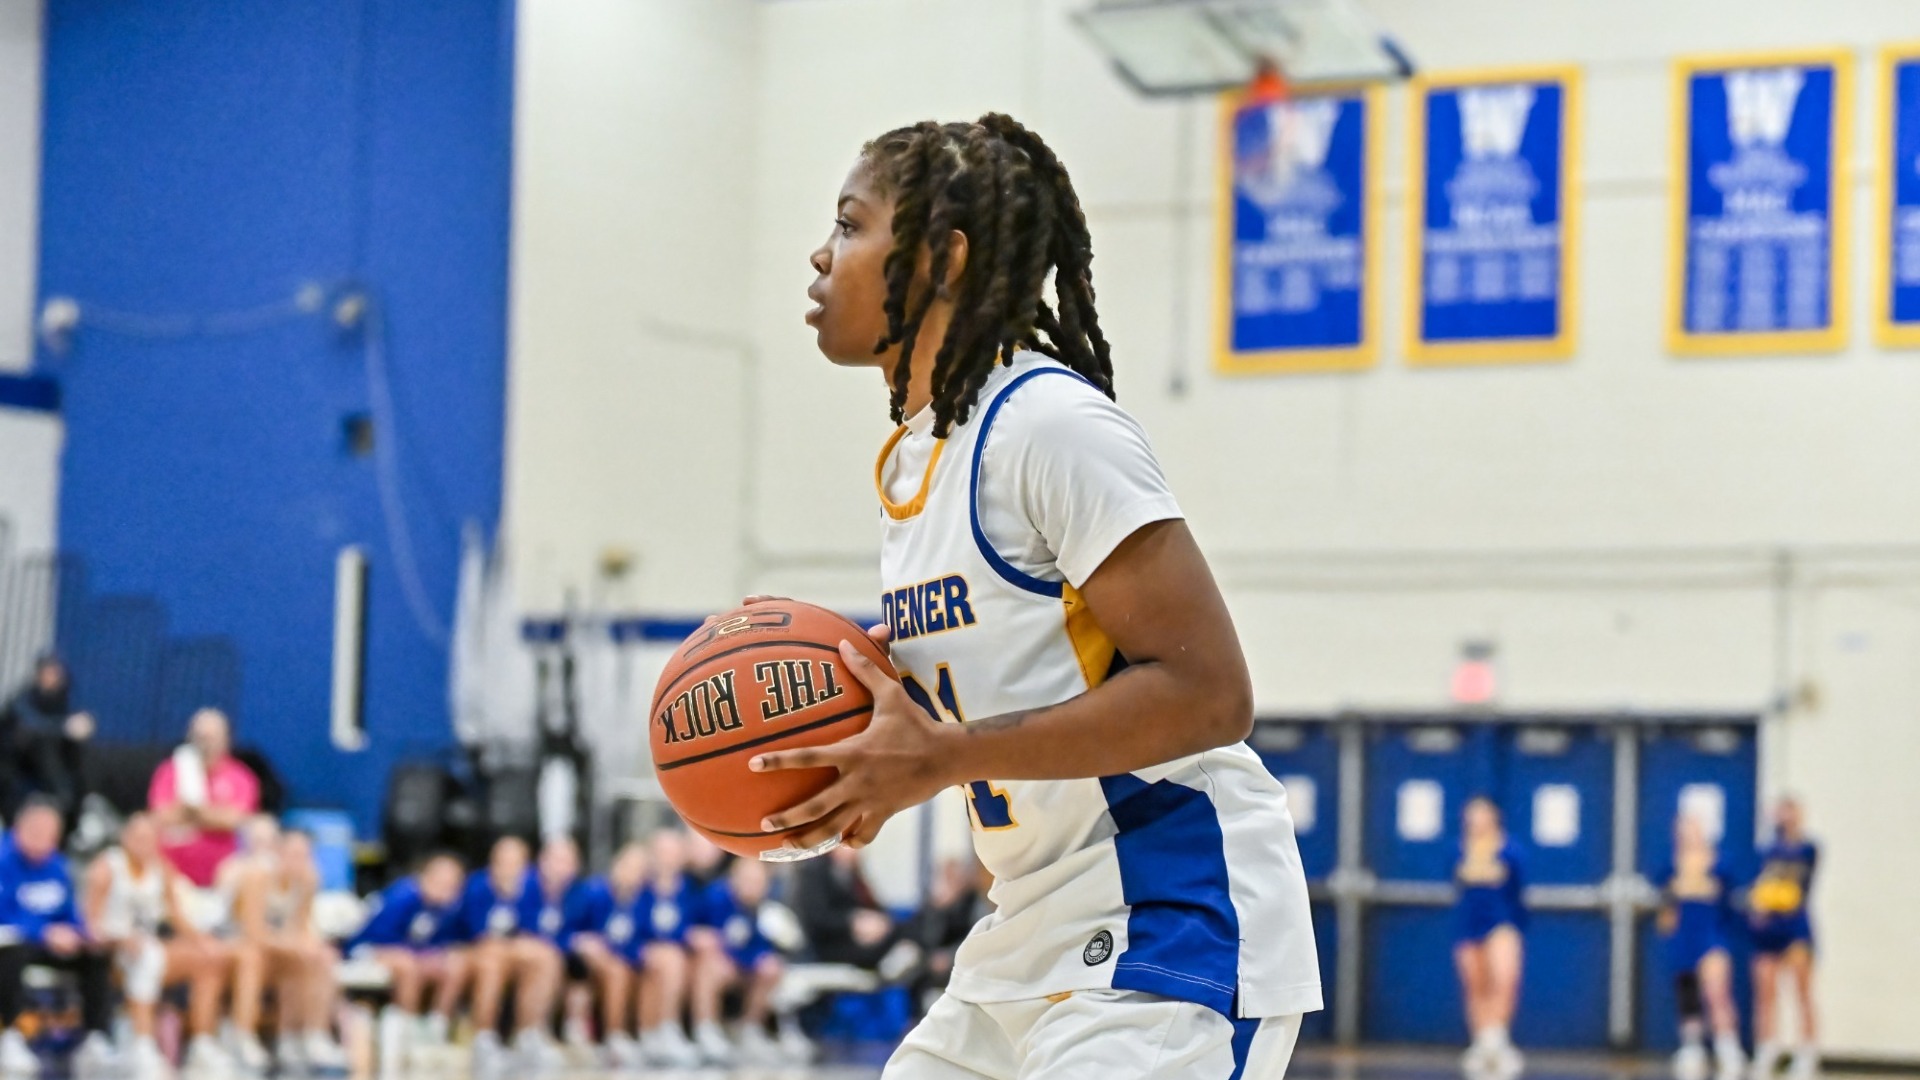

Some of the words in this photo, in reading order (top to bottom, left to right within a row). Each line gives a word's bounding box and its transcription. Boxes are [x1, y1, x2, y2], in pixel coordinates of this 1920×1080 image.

[882, 573, 977, 643] DENER
[658, 669, 743, 745] ROCK
[754, 660, 843, 722] THE
